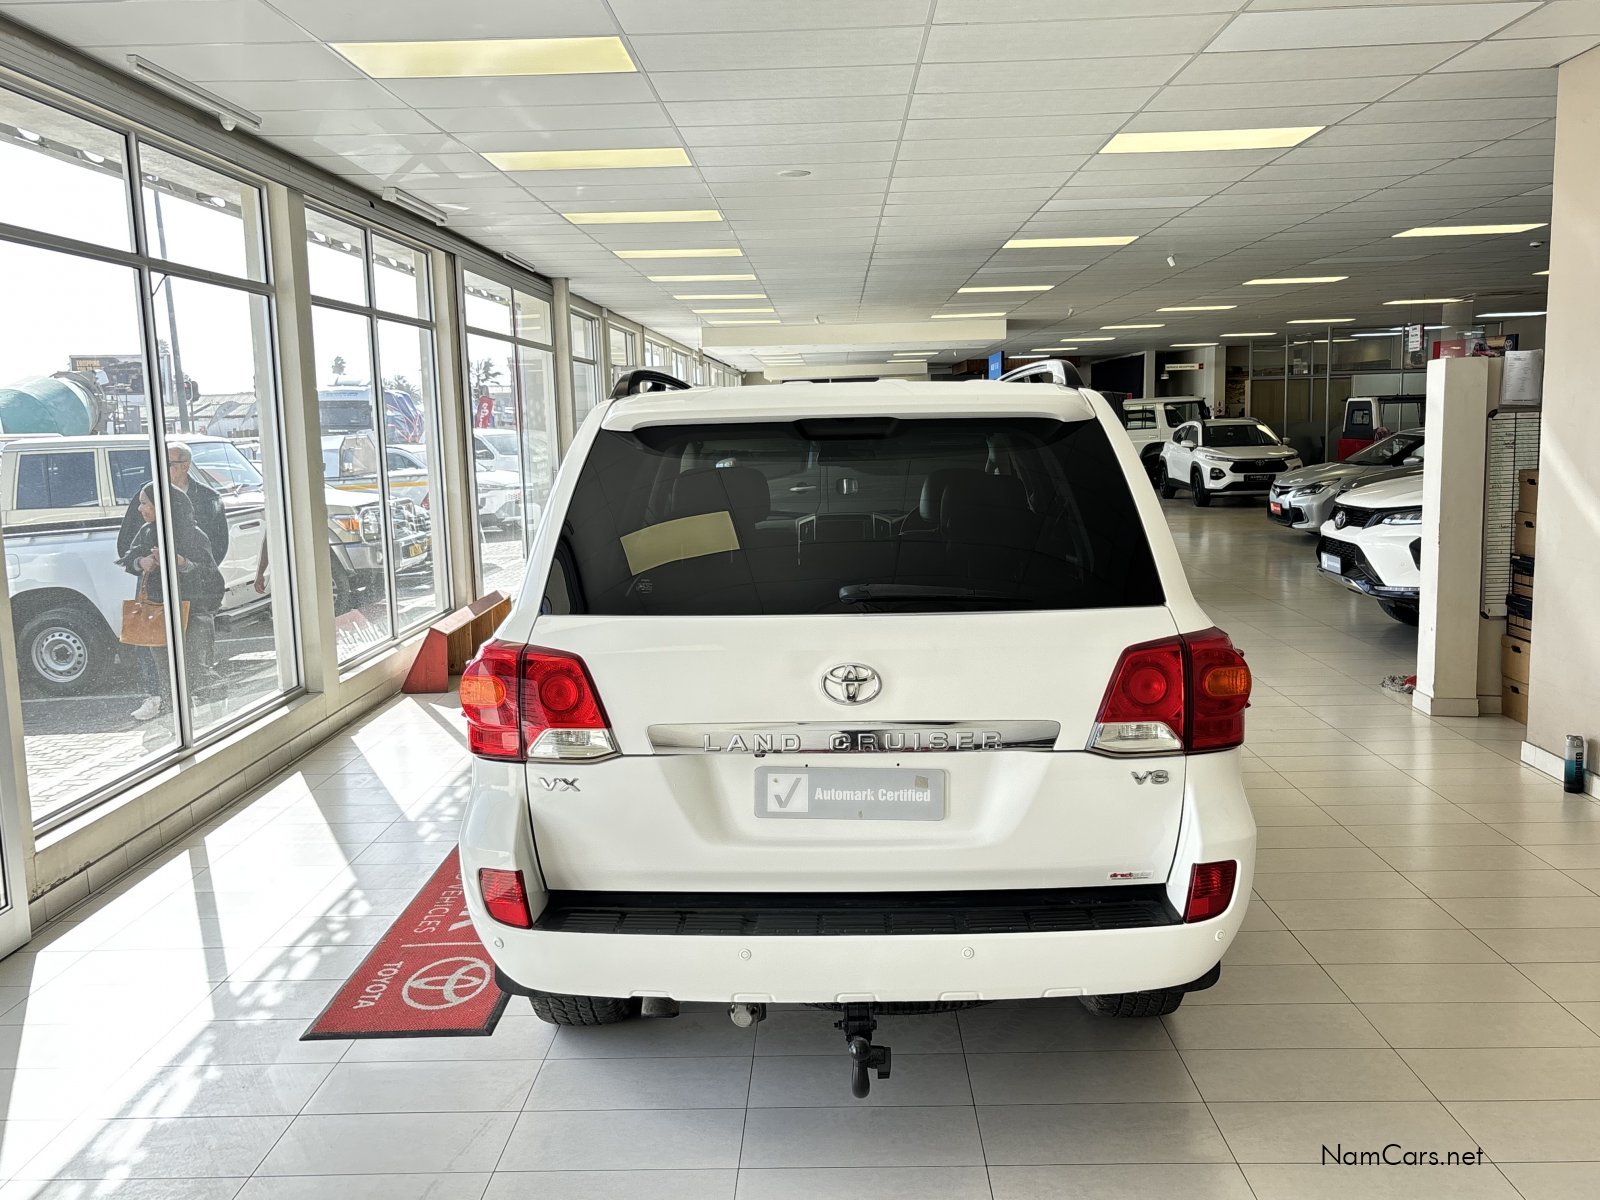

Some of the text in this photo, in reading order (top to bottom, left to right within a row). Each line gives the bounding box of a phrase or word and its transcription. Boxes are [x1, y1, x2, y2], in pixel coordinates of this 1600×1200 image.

[703, 731, 1003, 752] LAND CRUISER
[538, 777, 581, 792] VX
[1131, 769, 1169, 785] V8
[814, 787, 931, 802] Automark Certified
[413, 883, 463, 934] VEHICLES
[353, 960, 404, 1010] TOYOTA
